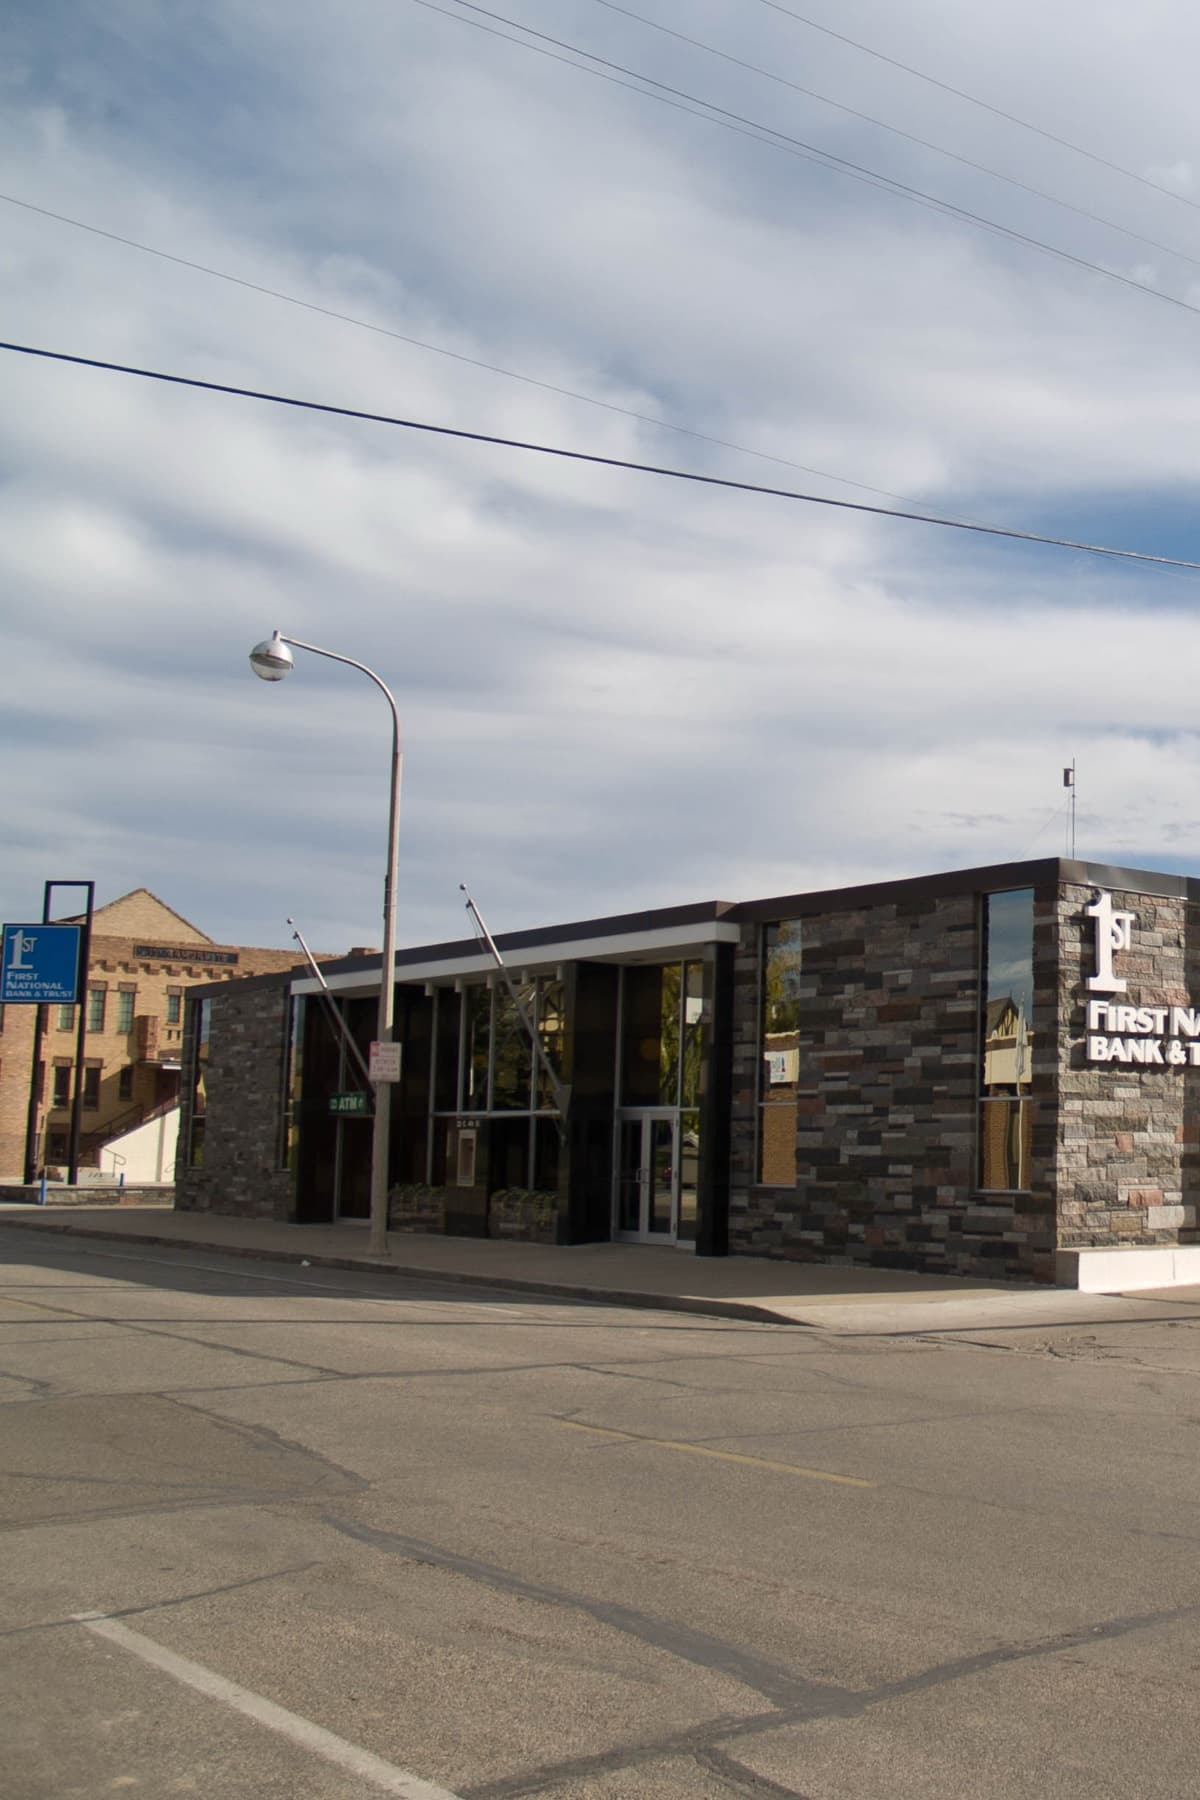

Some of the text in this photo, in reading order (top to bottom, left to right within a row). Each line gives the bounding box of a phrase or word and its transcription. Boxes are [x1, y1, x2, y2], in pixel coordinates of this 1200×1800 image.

[7, 971, 39, 980] FIRST
[7, 981, 64, 990] NATIONAL
[1087, 1000, 1169, 1036] FIRST
[1087, 1035, 1164, 1063] BANK
[1165, 1039, 1187, 1065] &
[338, 1096, 357, 1111] ATM
